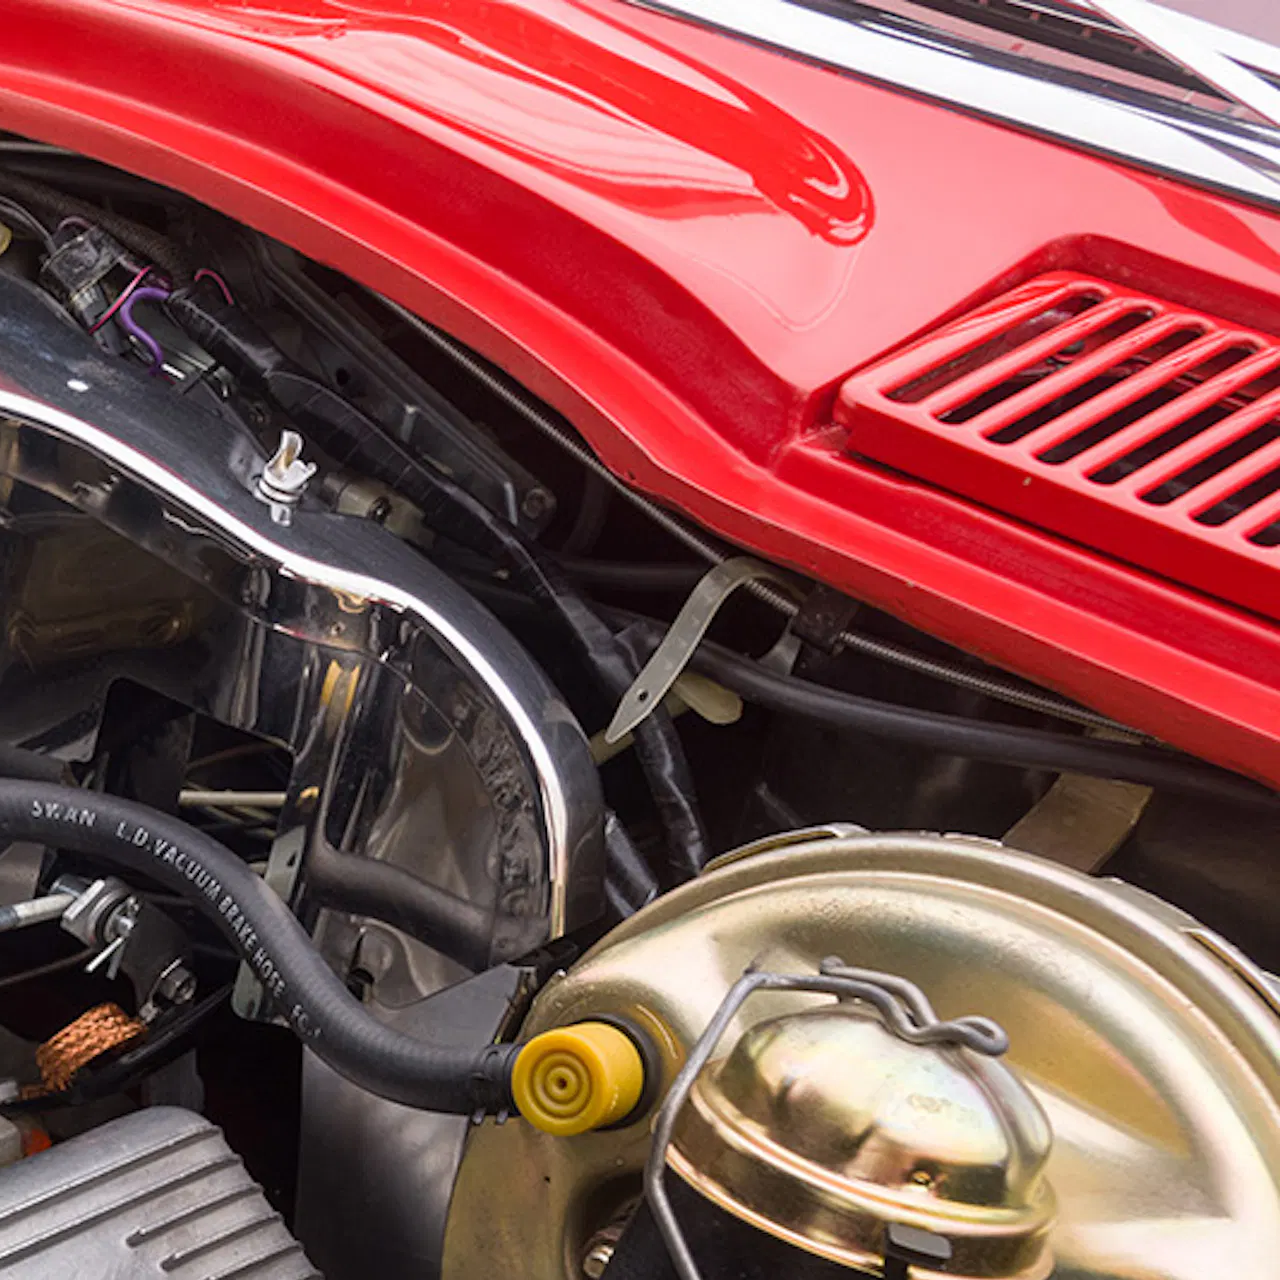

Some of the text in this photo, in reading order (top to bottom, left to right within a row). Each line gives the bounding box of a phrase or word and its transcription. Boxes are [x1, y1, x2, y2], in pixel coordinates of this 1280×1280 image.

[31, 800, 97, 828] SWAN
[217, 896, 257, 954] BRAKE
[251, 946, 287, 997] HOSE
